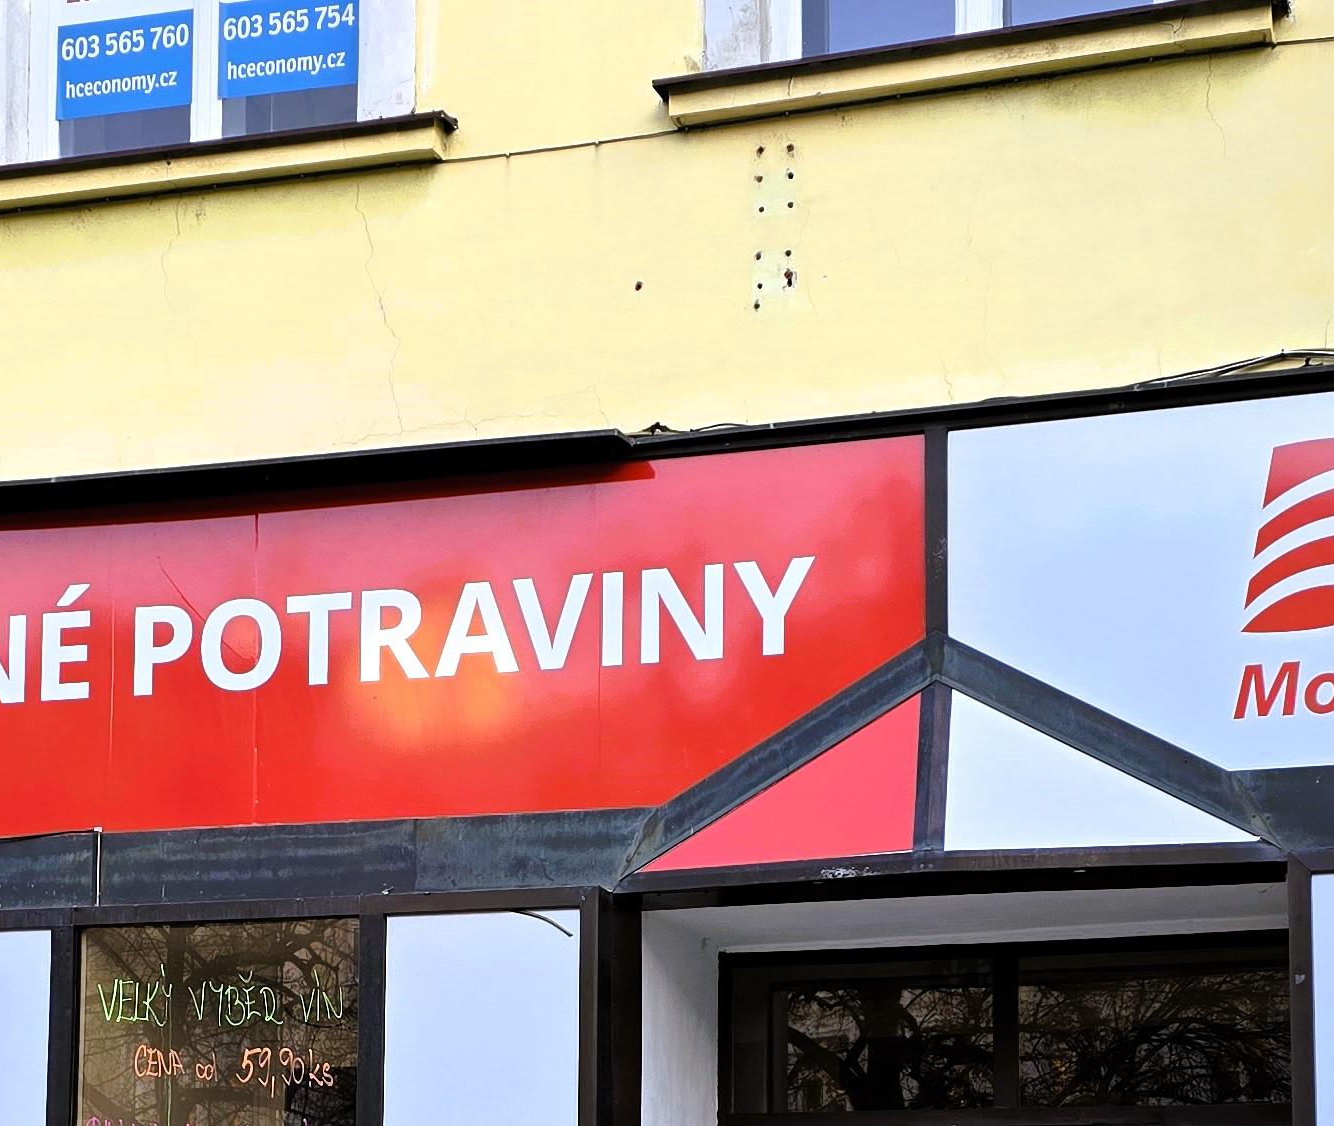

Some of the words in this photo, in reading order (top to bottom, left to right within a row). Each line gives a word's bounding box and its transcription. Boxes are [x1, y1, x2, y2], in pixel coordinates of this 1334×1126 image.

[223, 16, 264, 41] 603
[268, 9, 309, 36] 565
[314, 3, 355, 30] 754
[62, 35, 100, 61] 603
[105, 28, 145, 57] 565
[150, 23, 189, 51] 760
[66, 69, 178, 99] hceconomy.cz
[227, 51, 346, 80] hceconomy.cz
[133, 556, 815, 696] POTRAVINY
[134, 1045, 186, 1079] CENA
[196, 1052, 218, 1082] od
